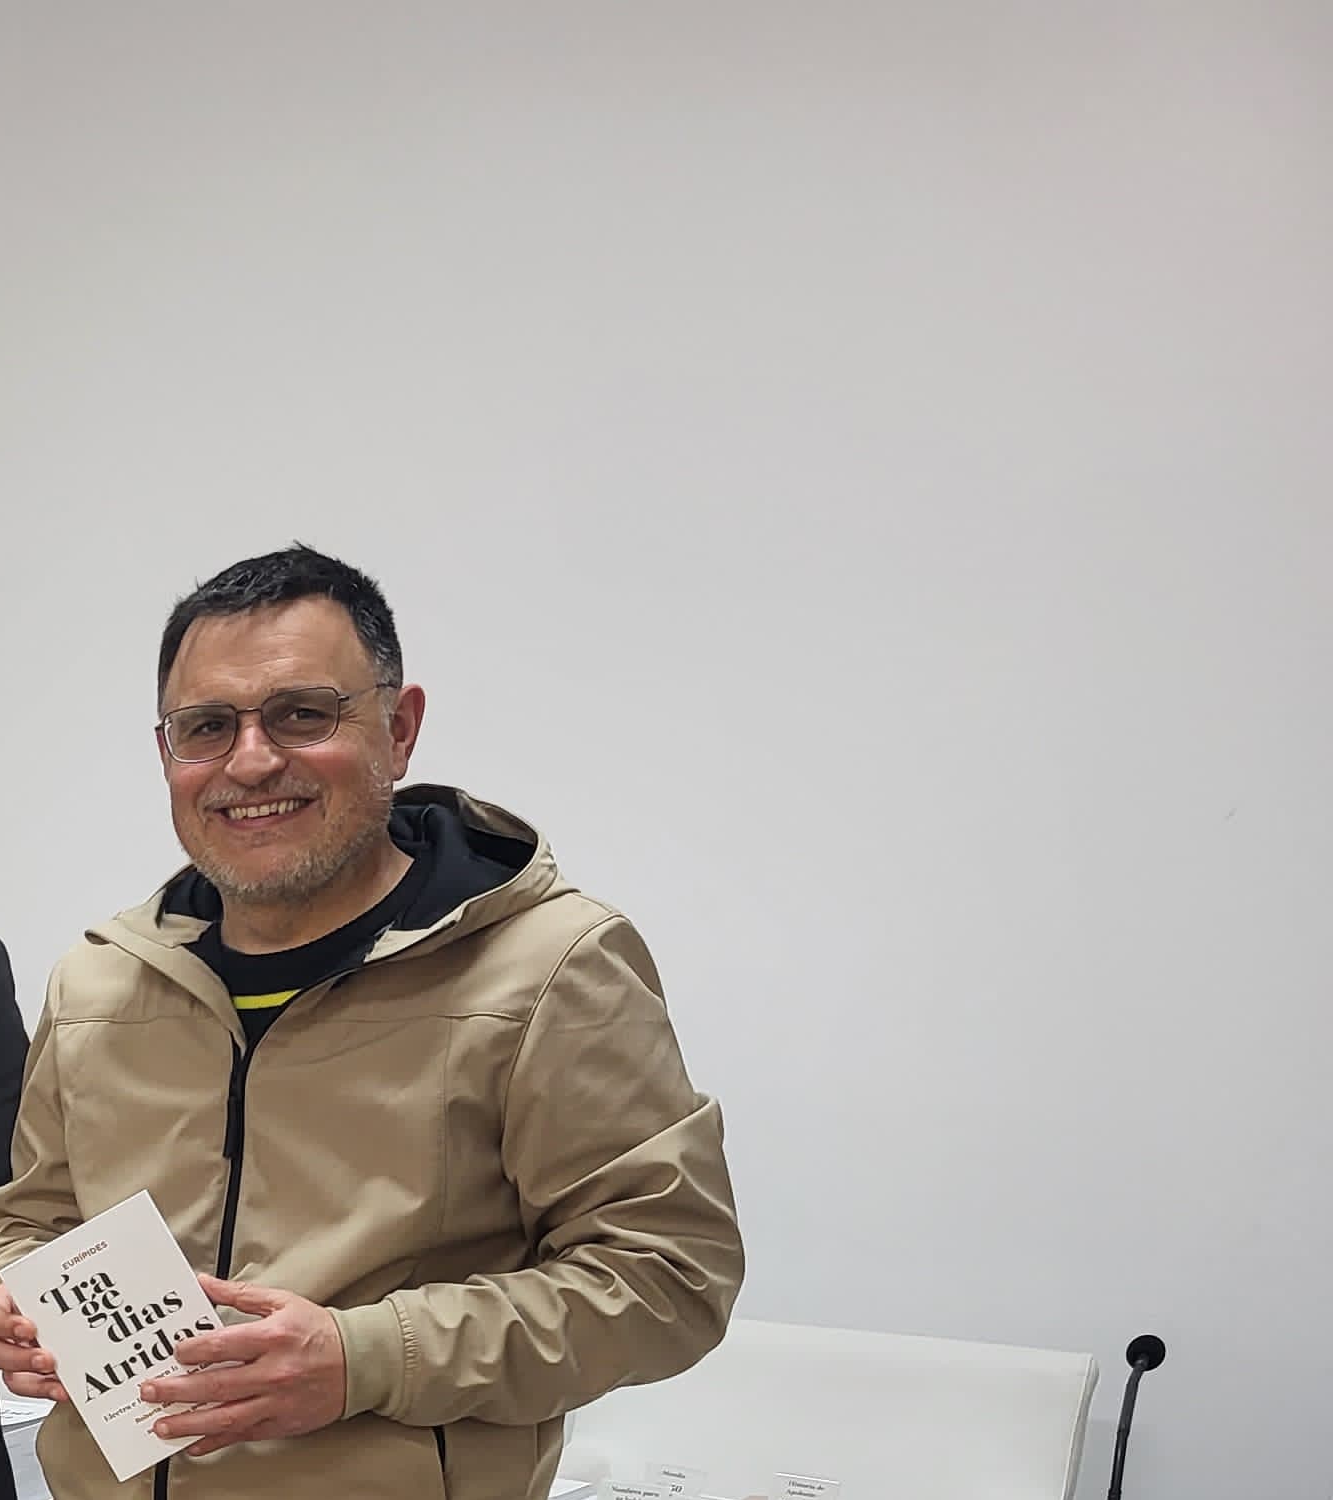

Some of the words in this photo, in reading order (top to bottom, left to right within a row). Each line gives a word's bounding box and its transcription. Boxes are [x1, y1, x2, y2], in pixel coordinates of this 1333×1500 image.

[62, 1240, 108, 1271] EURÍPIDES
[39, 1271, 116, 1315] Tra
[107, 1290, 183, 1343] dias
[84, 1315, 215, 1403] Atridas
